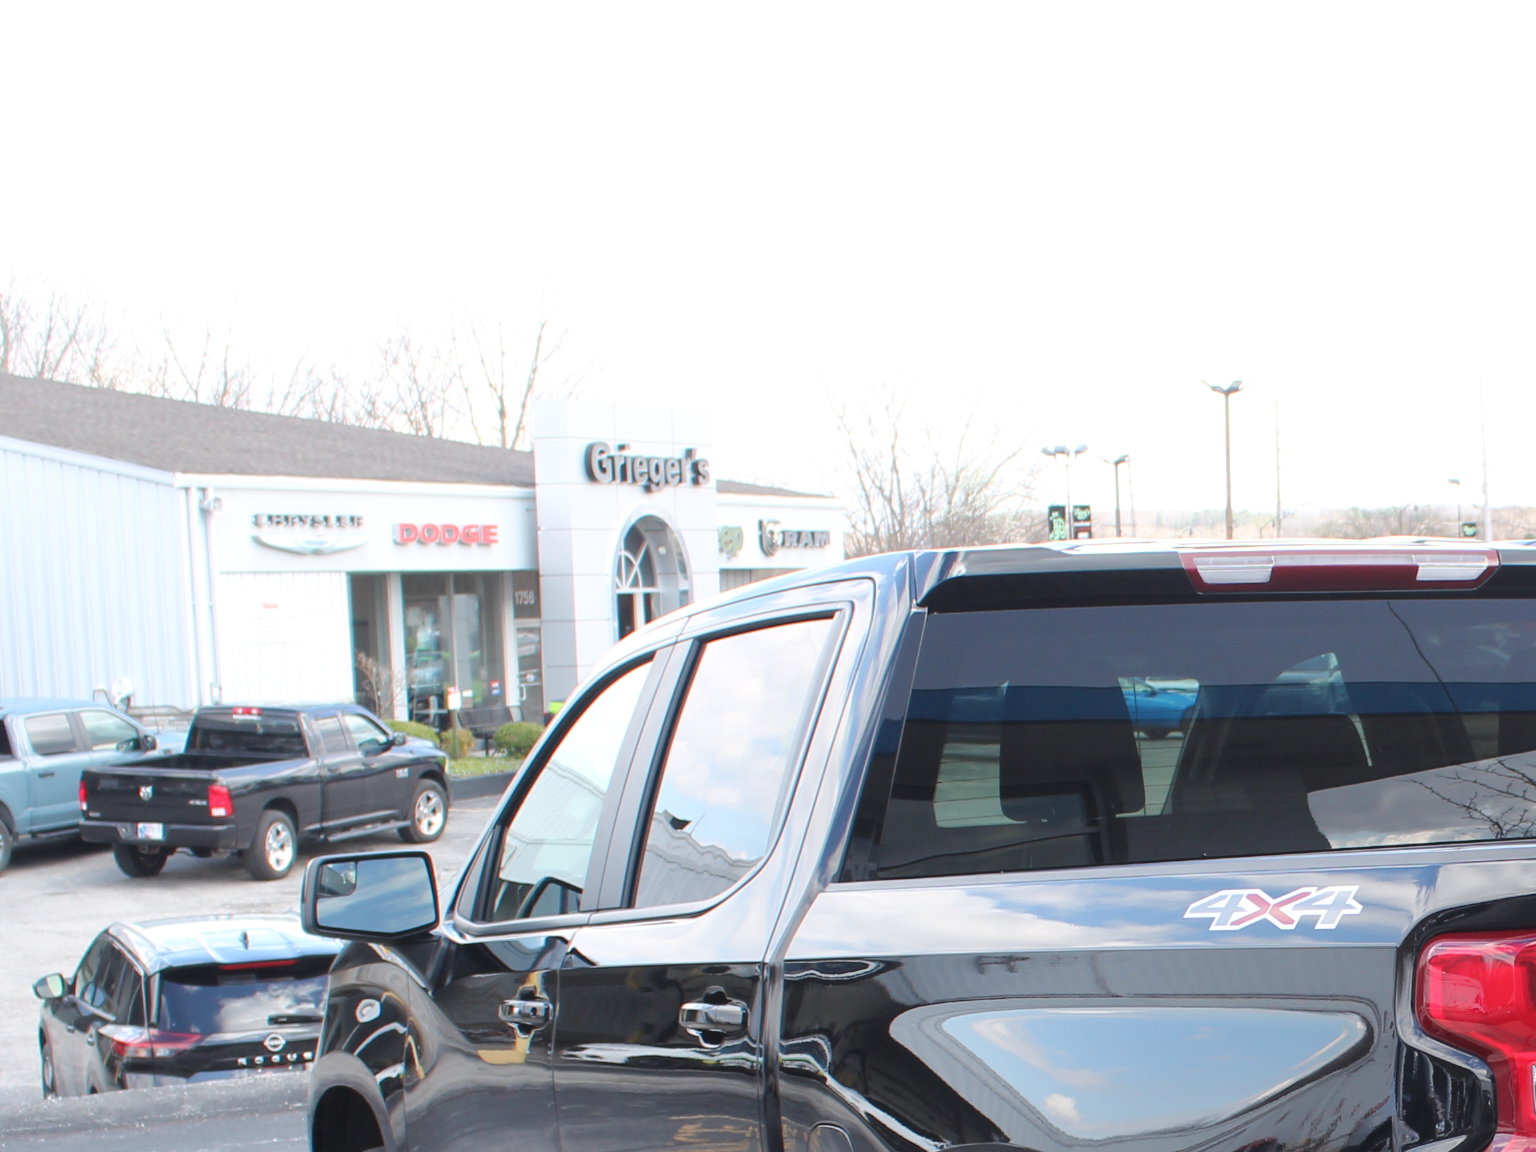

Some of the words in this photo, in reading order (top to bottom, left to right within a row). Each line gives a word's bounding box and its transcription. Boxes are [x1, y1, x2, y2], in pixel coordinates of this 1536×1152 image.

[585, 441, 710, 494] Grieger's
[393, 522, 499, 545] DODGE
[781, 530, 830, 548] RAM
